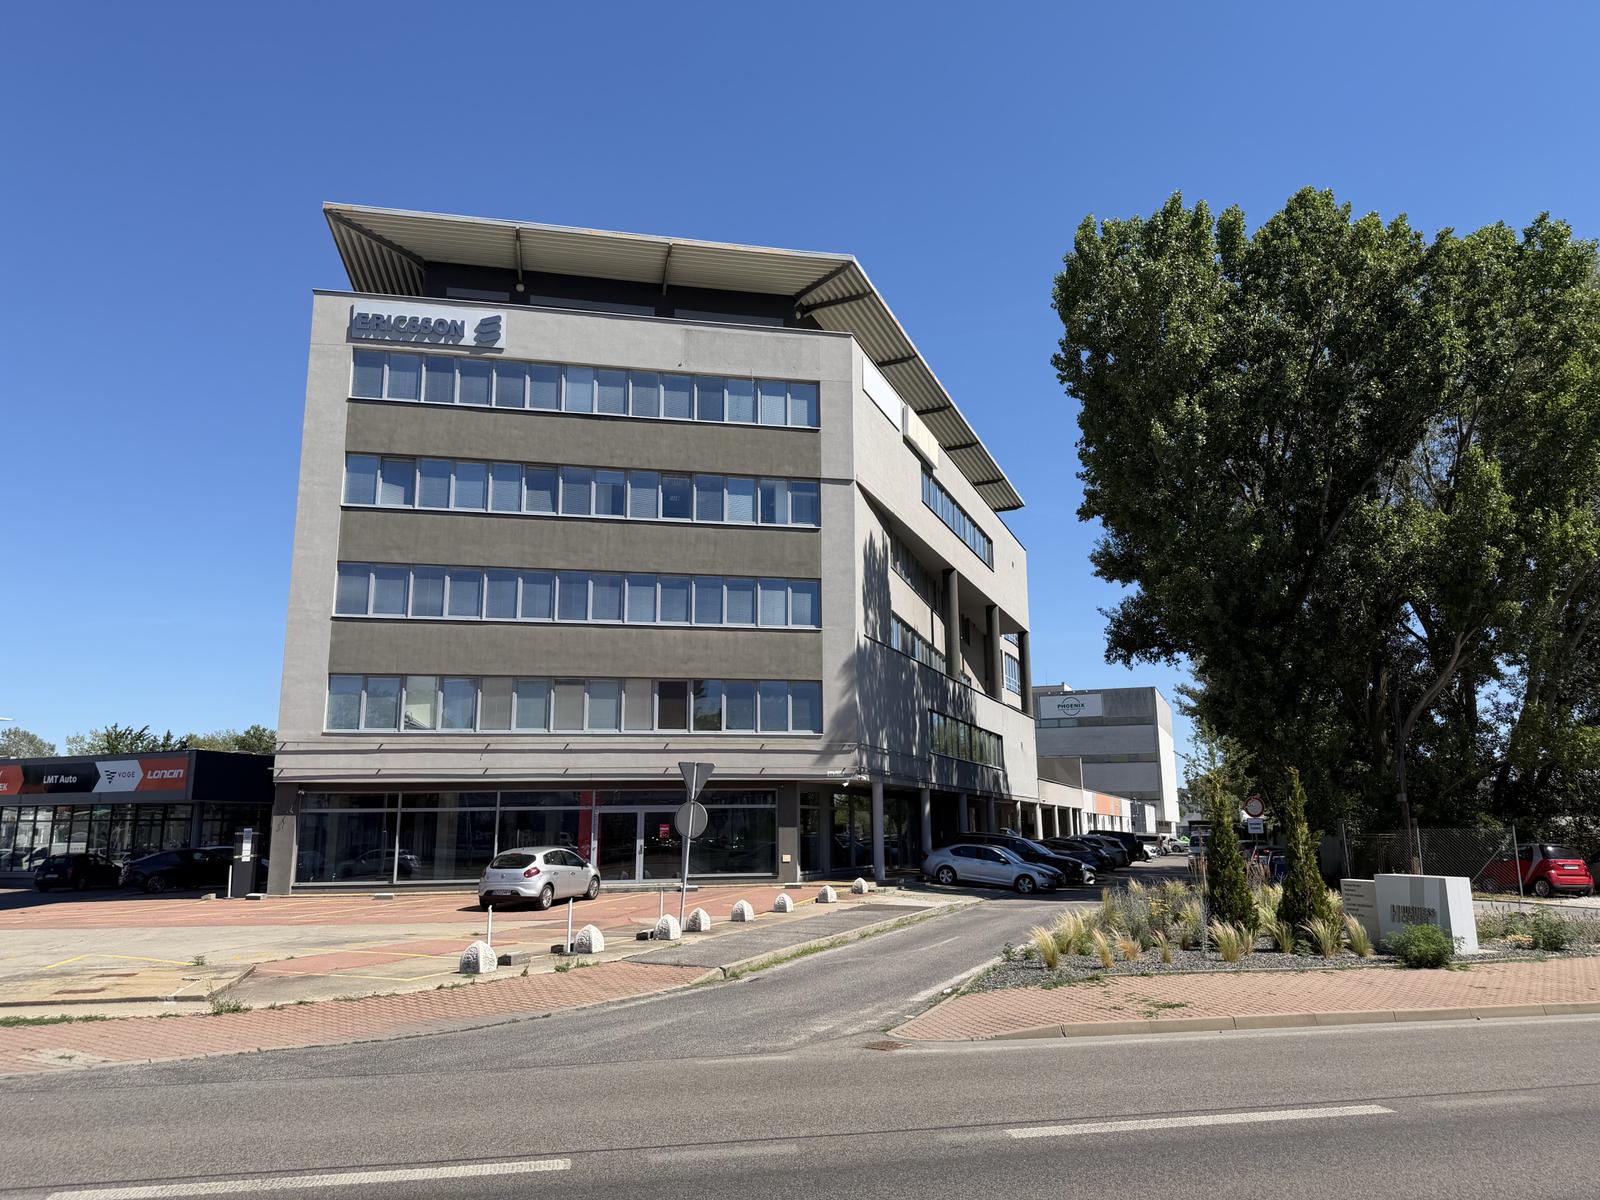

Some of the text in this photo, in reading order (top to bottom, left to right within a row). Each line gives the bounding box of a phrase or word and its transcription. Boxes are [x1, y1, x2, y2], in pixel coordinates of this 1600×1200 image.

[353, 312, 466, 337] ERICSSON
[43, 774, 78, 784] LMT Auto
